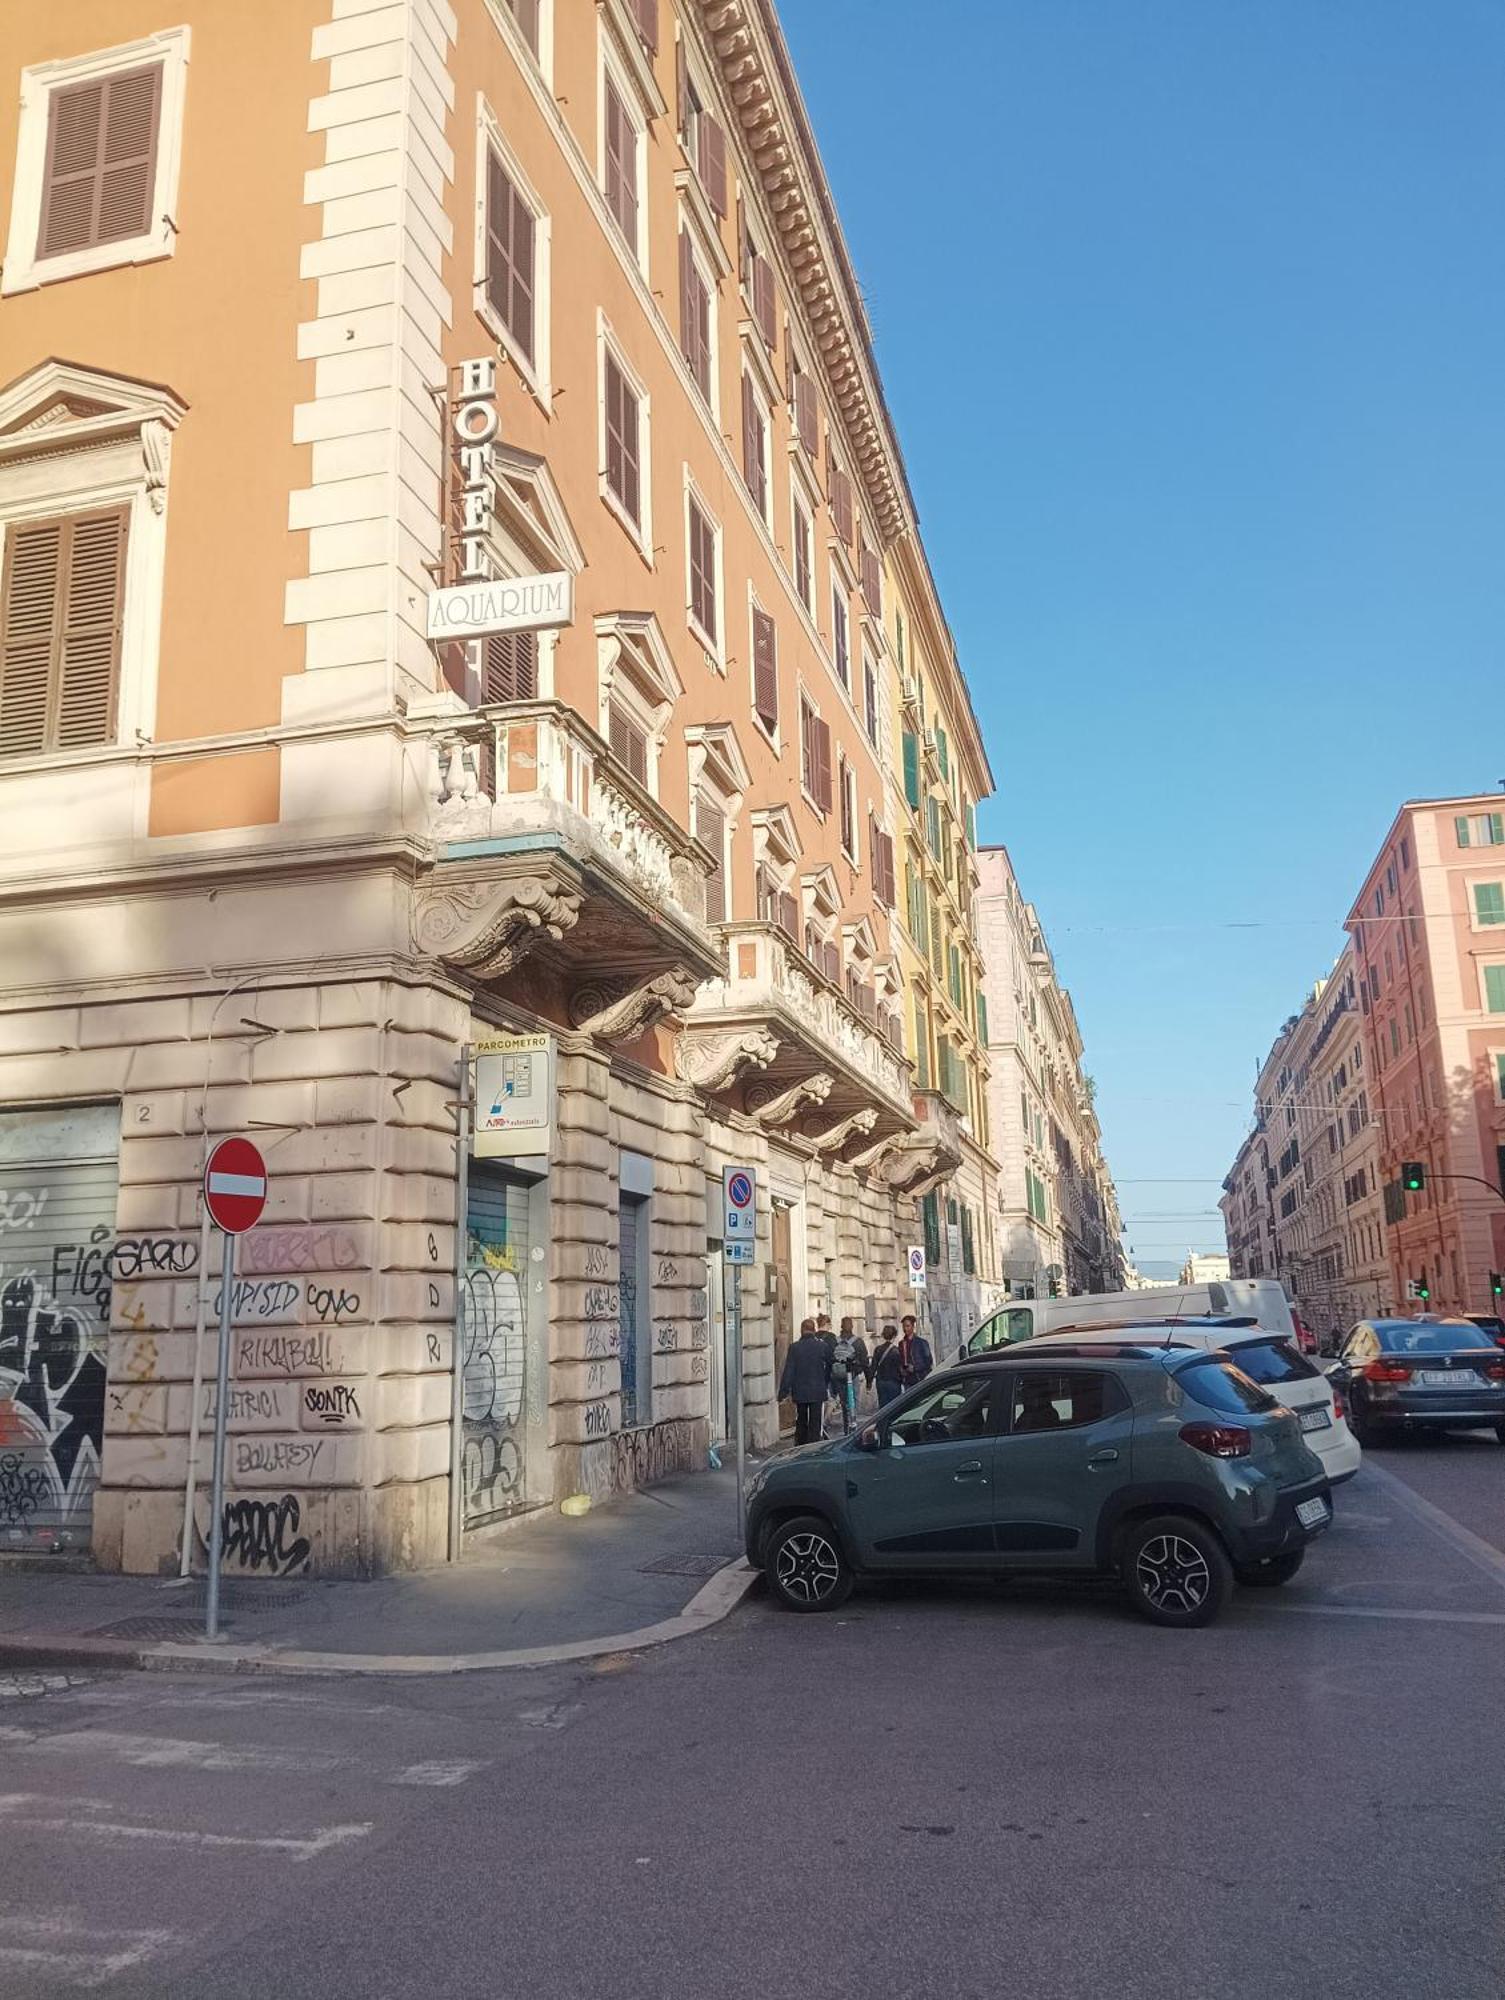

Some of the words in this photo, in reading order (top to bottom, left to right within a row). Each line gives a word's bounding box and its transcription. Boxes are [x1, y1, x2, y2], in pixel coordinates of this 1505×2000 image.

[455, 356, 499, 579] HOTEL
[431, 581, 563, 627] AQUARIUM
[477, 1037, 547, 1051] PARCOMETRO
[139, 1106, 152, 1122] 2
